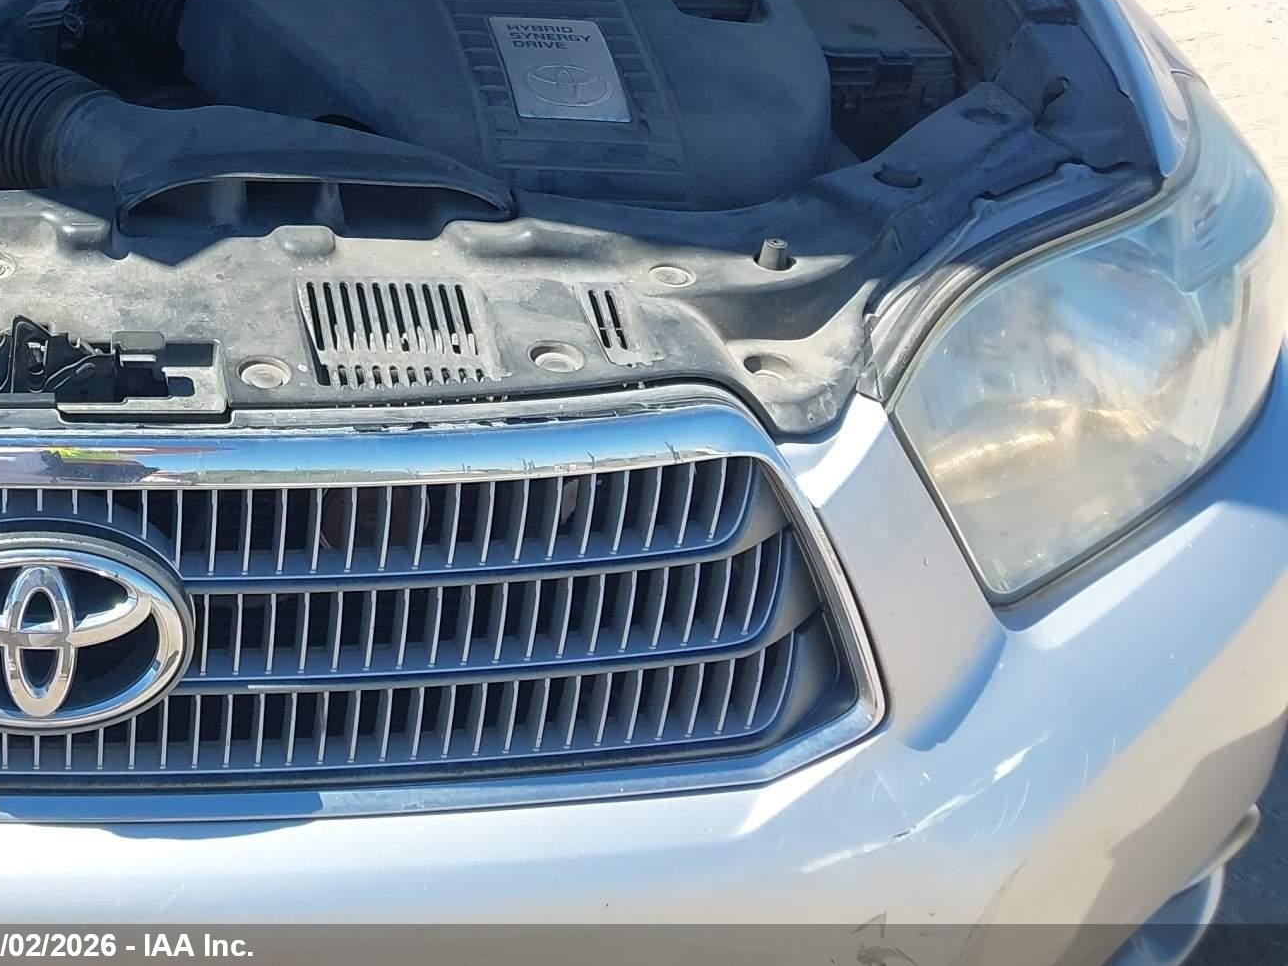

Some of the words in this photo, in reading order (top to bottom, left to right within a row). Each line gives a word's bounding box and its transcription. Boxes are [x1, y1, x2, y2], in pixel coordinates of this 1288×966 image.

[507, 24, 573, 34] HYBRID
[509, 32, 591, 43] SYNERGY
[513, 40, 567, 50] DRIVE
